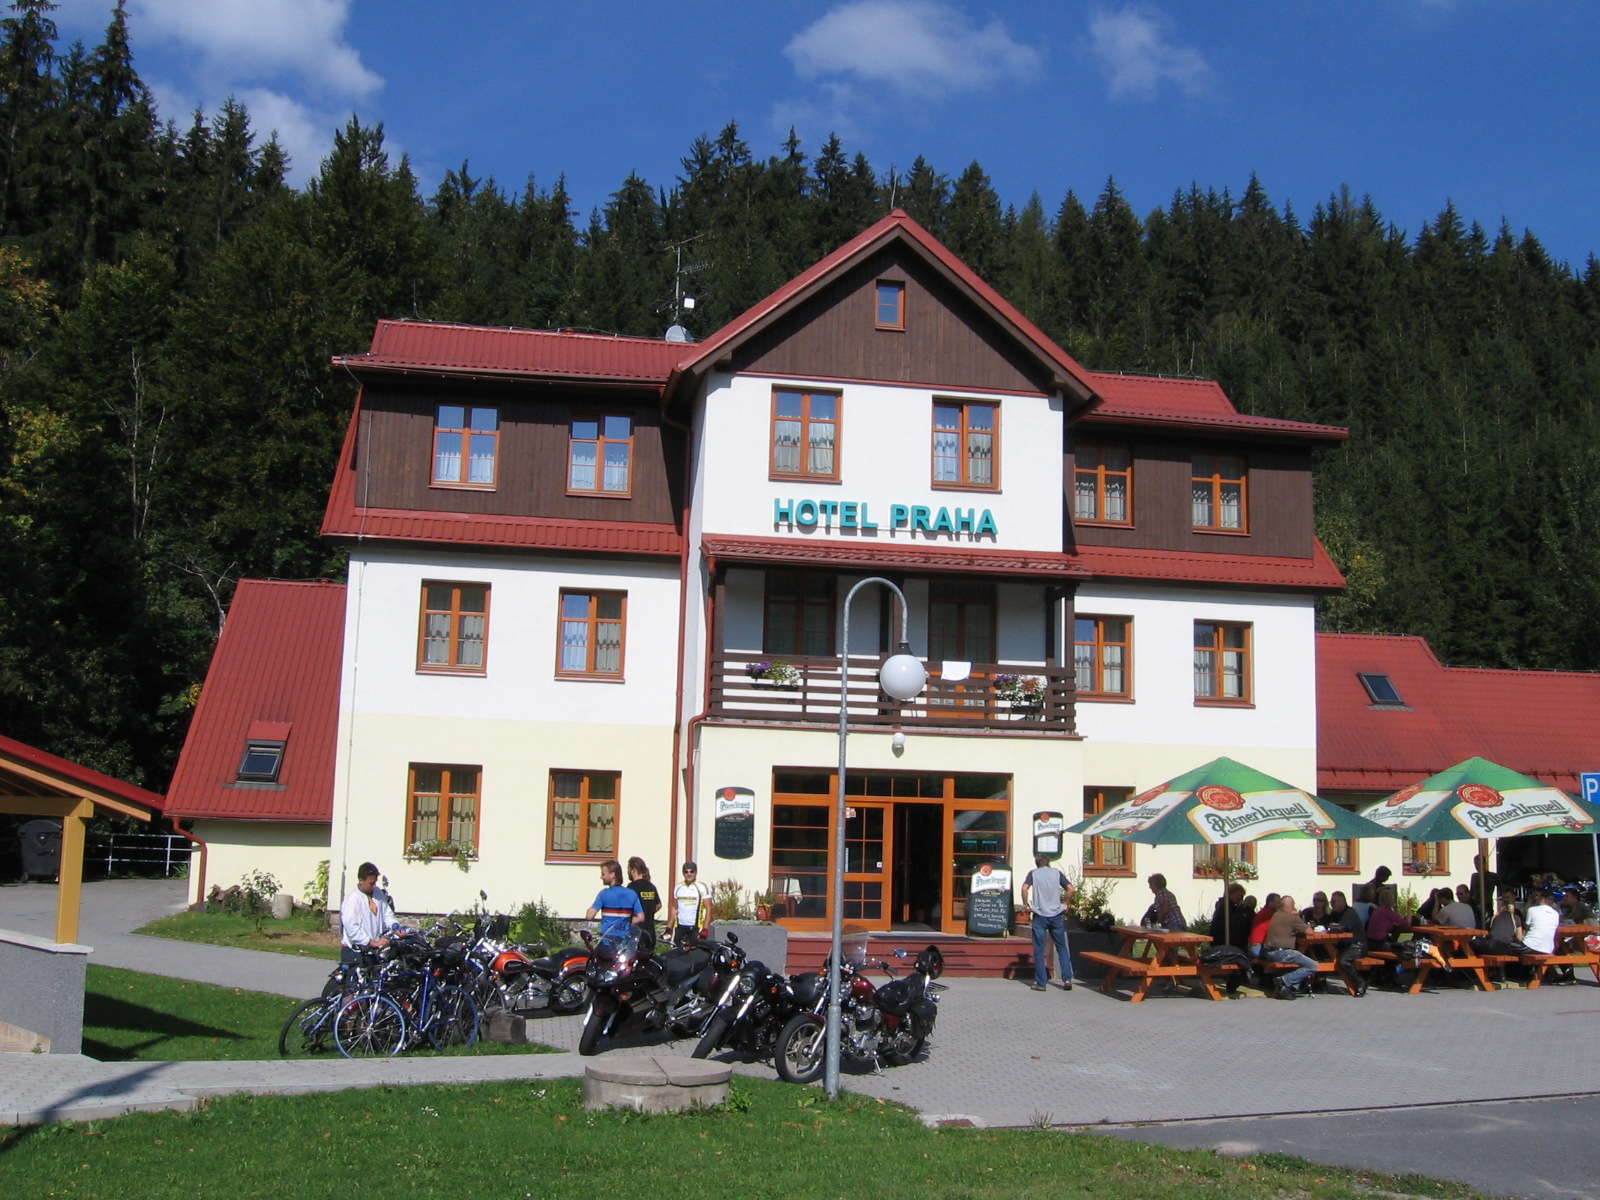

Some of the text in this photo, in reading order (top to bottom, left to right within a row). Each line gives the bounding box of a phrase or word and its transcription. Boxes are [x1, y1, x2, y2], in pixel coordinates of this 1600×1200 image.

[774, 498, 998, 534] HOTEL PRAHA
[1585, 777, 1599, 802] P
[1204, 803, 1309, 838] Pilsner Urquell
[1467, 800, 1566, 833] Pilsner Urquell
